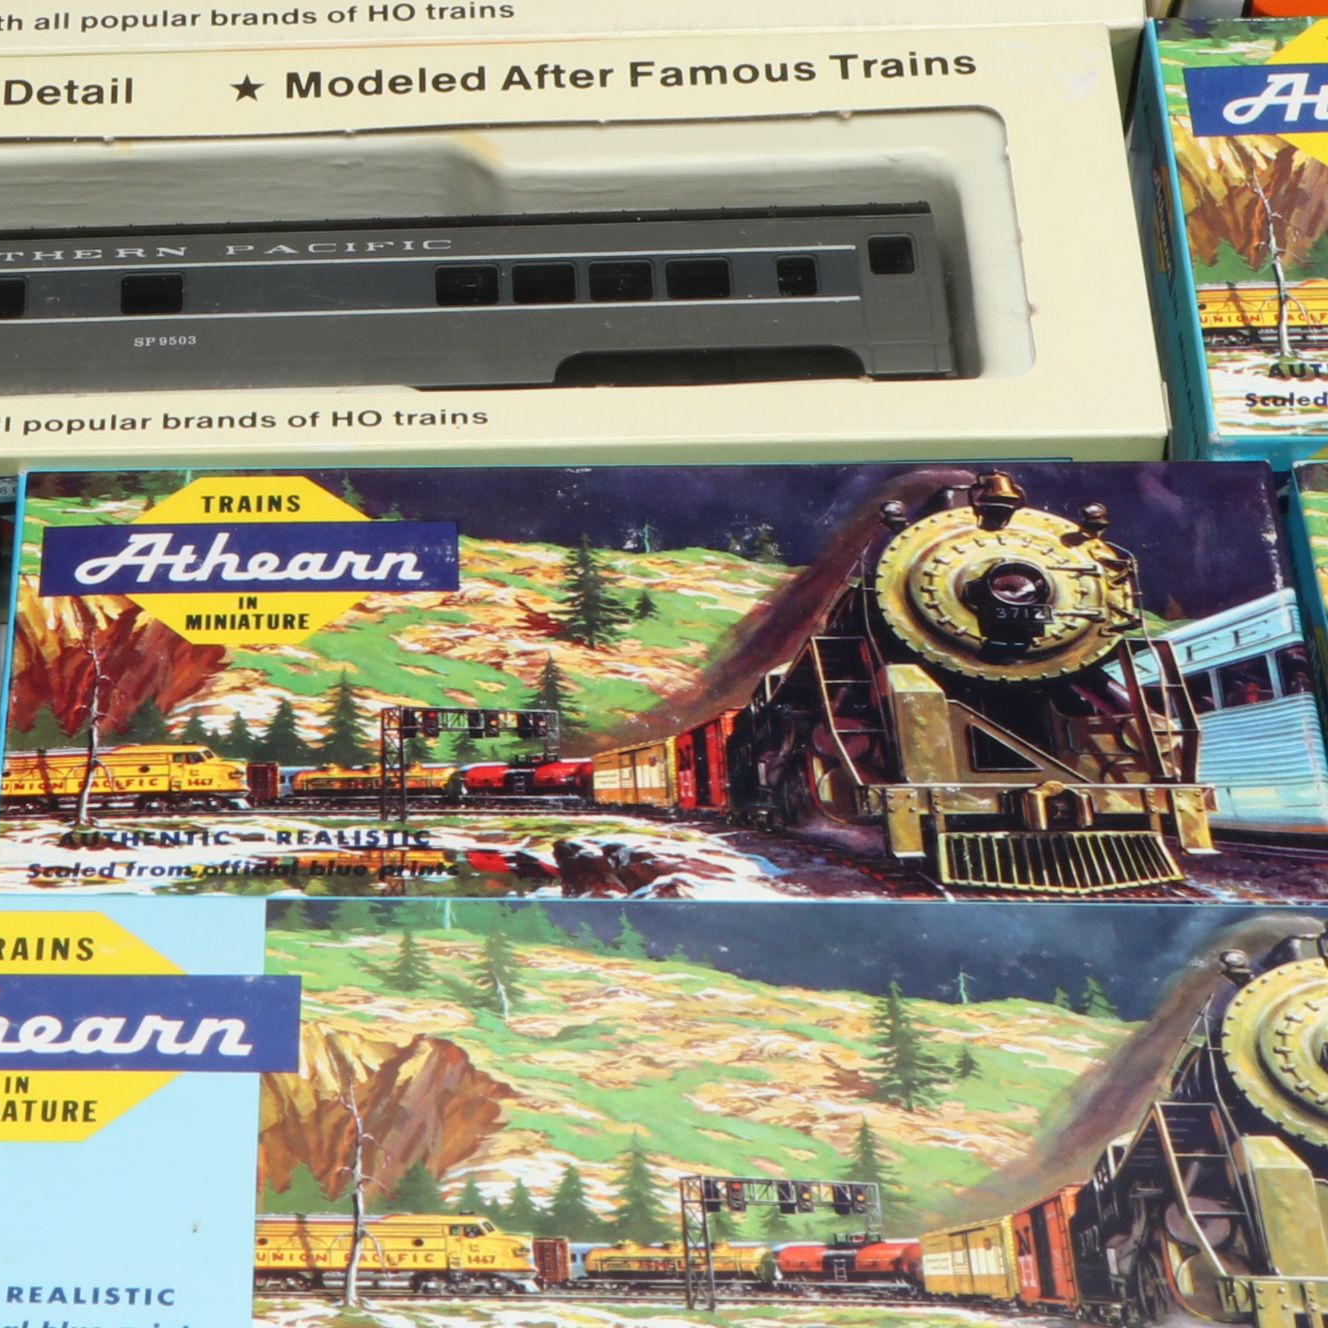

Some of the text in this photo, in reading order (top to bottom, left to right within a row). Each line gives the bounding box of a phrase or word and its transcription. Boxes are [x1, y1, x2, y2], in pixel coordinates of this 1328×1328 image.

[33, 12, 70, 31] all
[81, 9, 202, 32] popular
[211, 6, 318, 26] brands
[326, 5, 358, 24] of
[369, 3, 416, 23] HO
[425, 0, 516, 21] trains
[3, 77, 134, 107] Detail
[285, 66, 485, 99] Modeled
[501, 64, 613, 91] After
[629, 57, 816, 87] Famous
[829, 50, 976, 81] Trains
[225, 238, 453, 256] PACIFIC
[1199, 314, 1260, 324] UNION
[133, 335, 197, 346] SP 9503
[1245, 391, 1328, 408] Scaled
[23, 413, 152, 435] popular
[162, 409, 276, 430] brands
[287, 408, 320, 428] of
[331, 408, 382, 427] HO
[392, 407, 488, 426] trains
[203, 495, 301, 513] TRAINS
[75, 534, 422, 585] Athearn
[238, 597, 257, 610] IN
[185, 613, 310, 631] MINIATURE
[996, 608, 1045, 619] 3712
[0, 782, 63, 791] UNION
[57, 830, 430, 847] AUTHENTIC REALISTIC
[27, 862, 116, 878] Scaled
[125, 861, 190, 877] from
[309, 860, 368, 876] blue
[378, 861, 459, 881] prints
[4, 1076, 29, 1094] IN
[255, 1253, 328, 1262] UNION
[467, 1255, 496, 1264] 1467
[6, 1285, 176, 1306] REALISTIC
